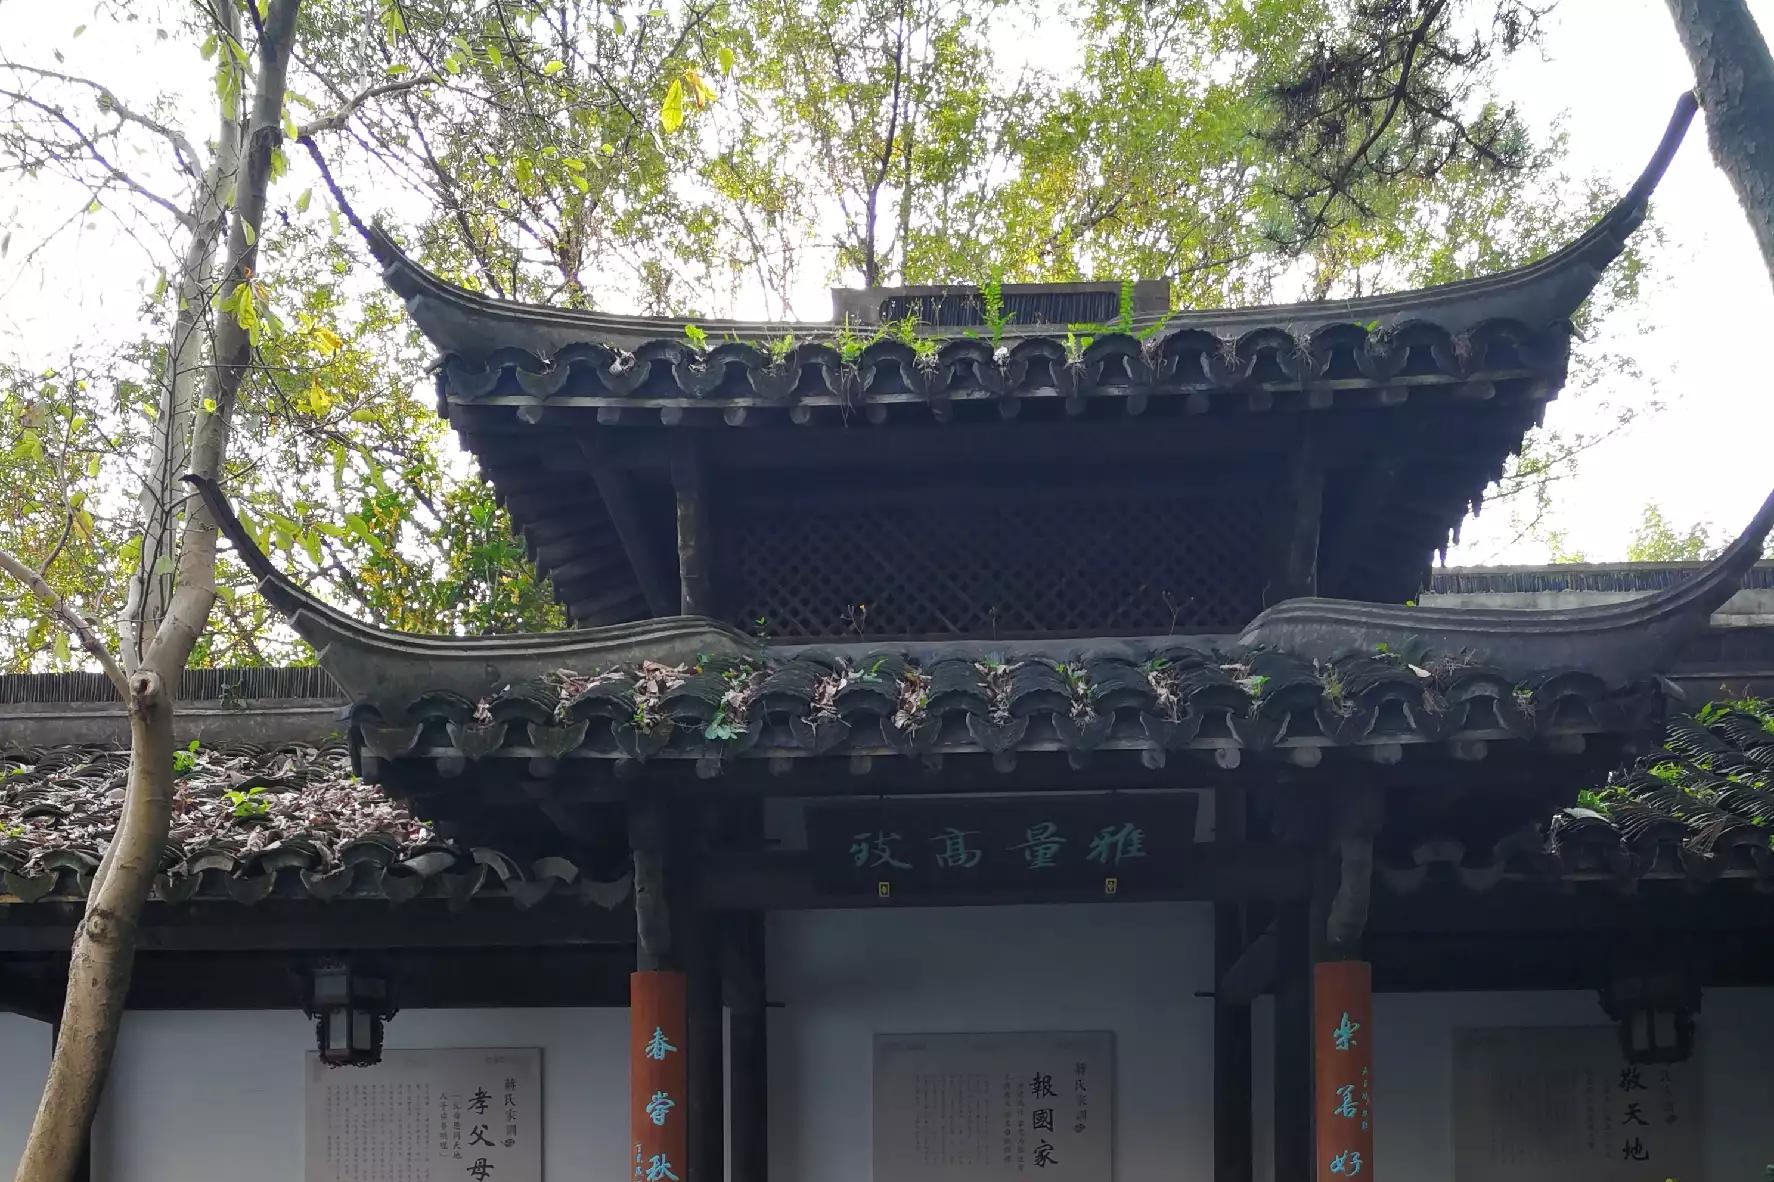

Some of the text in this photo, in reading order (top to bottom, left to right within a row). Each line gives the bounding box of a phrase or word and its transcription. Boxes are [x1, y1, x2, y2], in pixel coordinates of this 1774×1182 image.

[466, 1086, 497, 1182] 孝父母
[1028, 1071, 1059, 1169] 報國家
[1618, 1067, 1651, 1162] 敬天地
